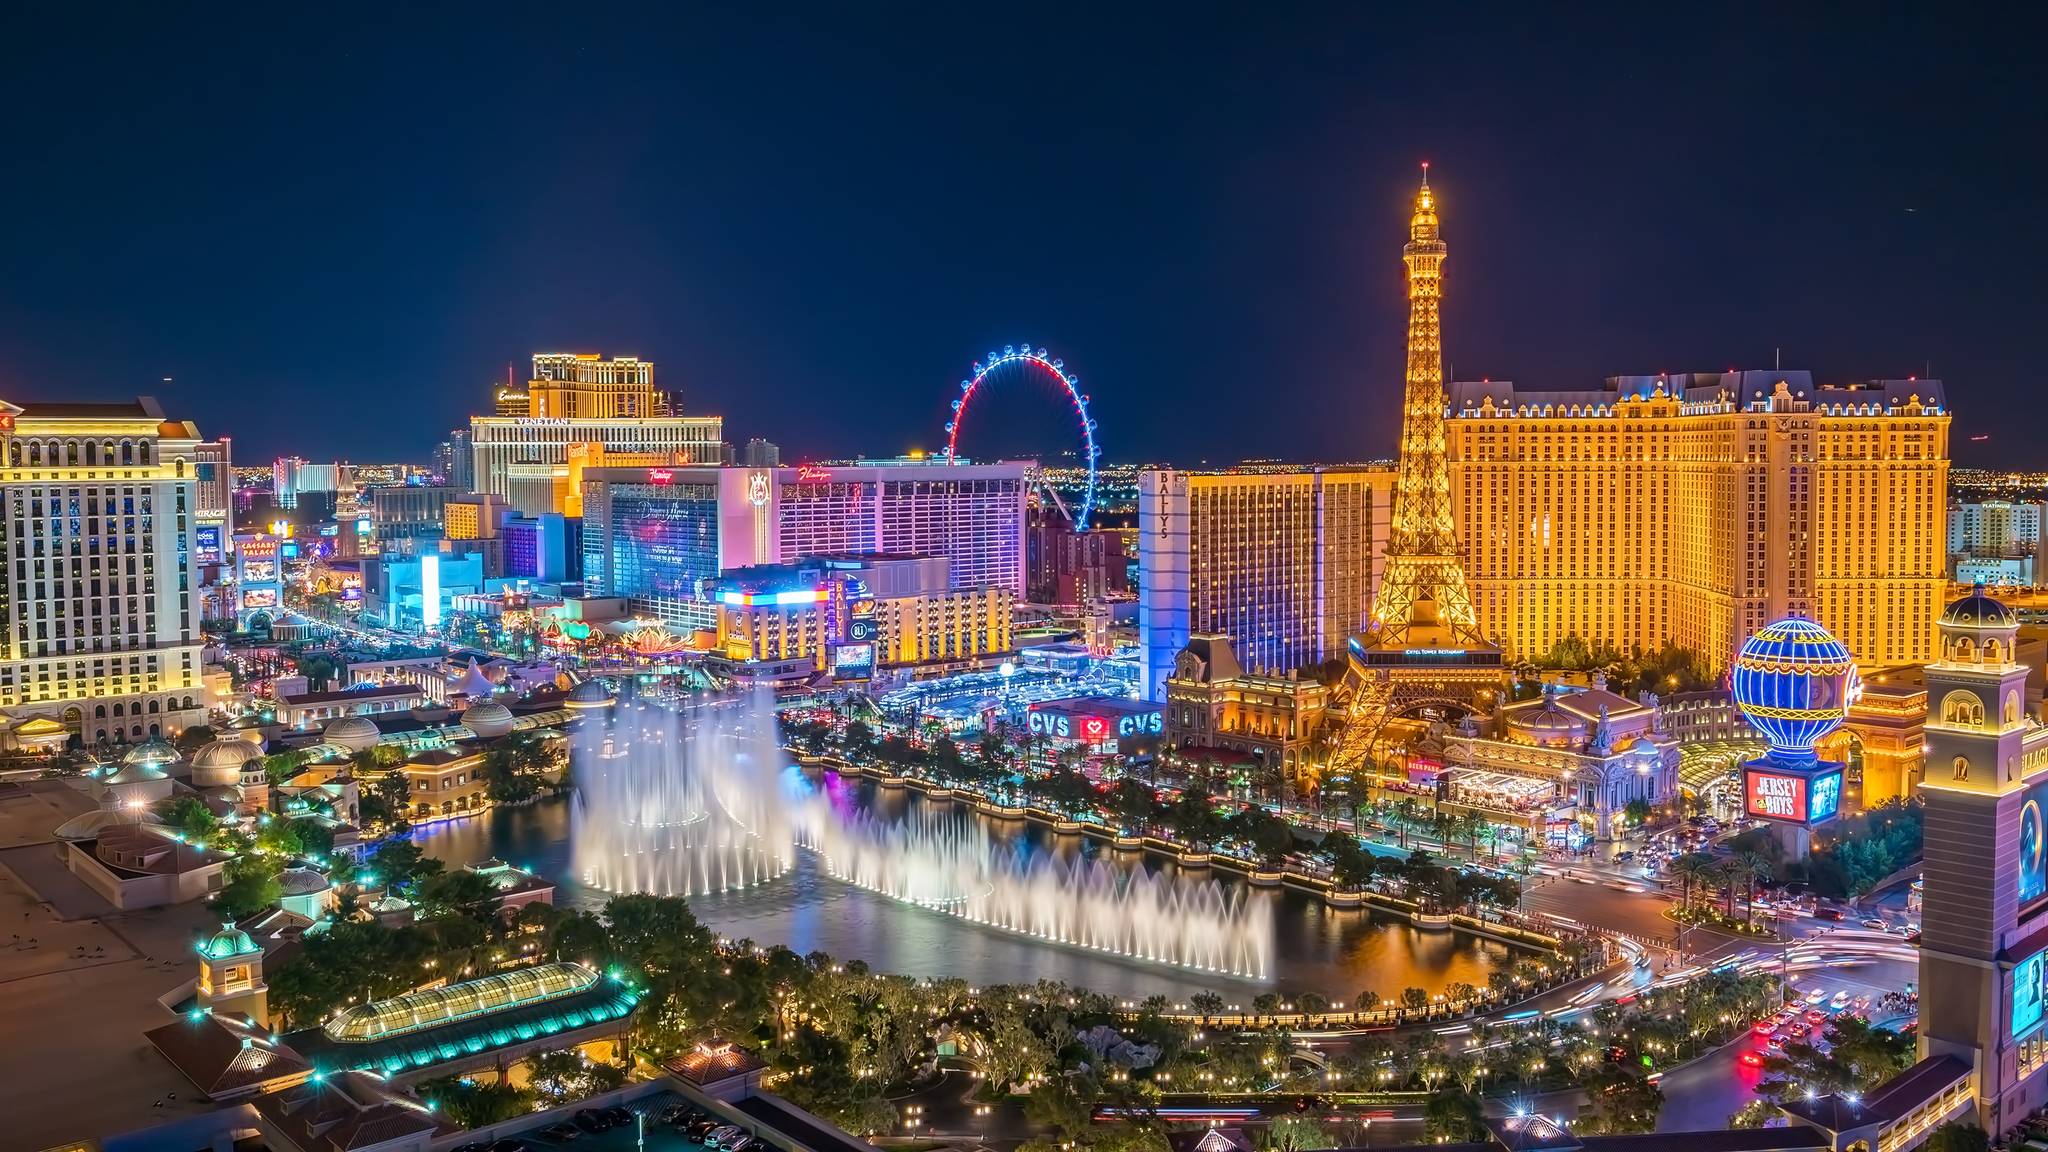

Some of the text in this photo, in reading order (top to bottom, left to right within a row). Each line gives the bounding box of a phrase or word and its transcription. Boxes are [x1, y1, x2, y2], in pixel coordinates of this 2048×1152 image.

[517, 417, 568, 425] VENETIAN
[1159, 472, 1169, 539] BALLYS
[243, 549, 274, 557] PALACE
[1029, 712, 1069, 737] CVS
[1119, 712, 1163, 737] CVS
[1757, 777, 1797, 797] JERSEY
[1765, 796, 1794, 816] BOYS
